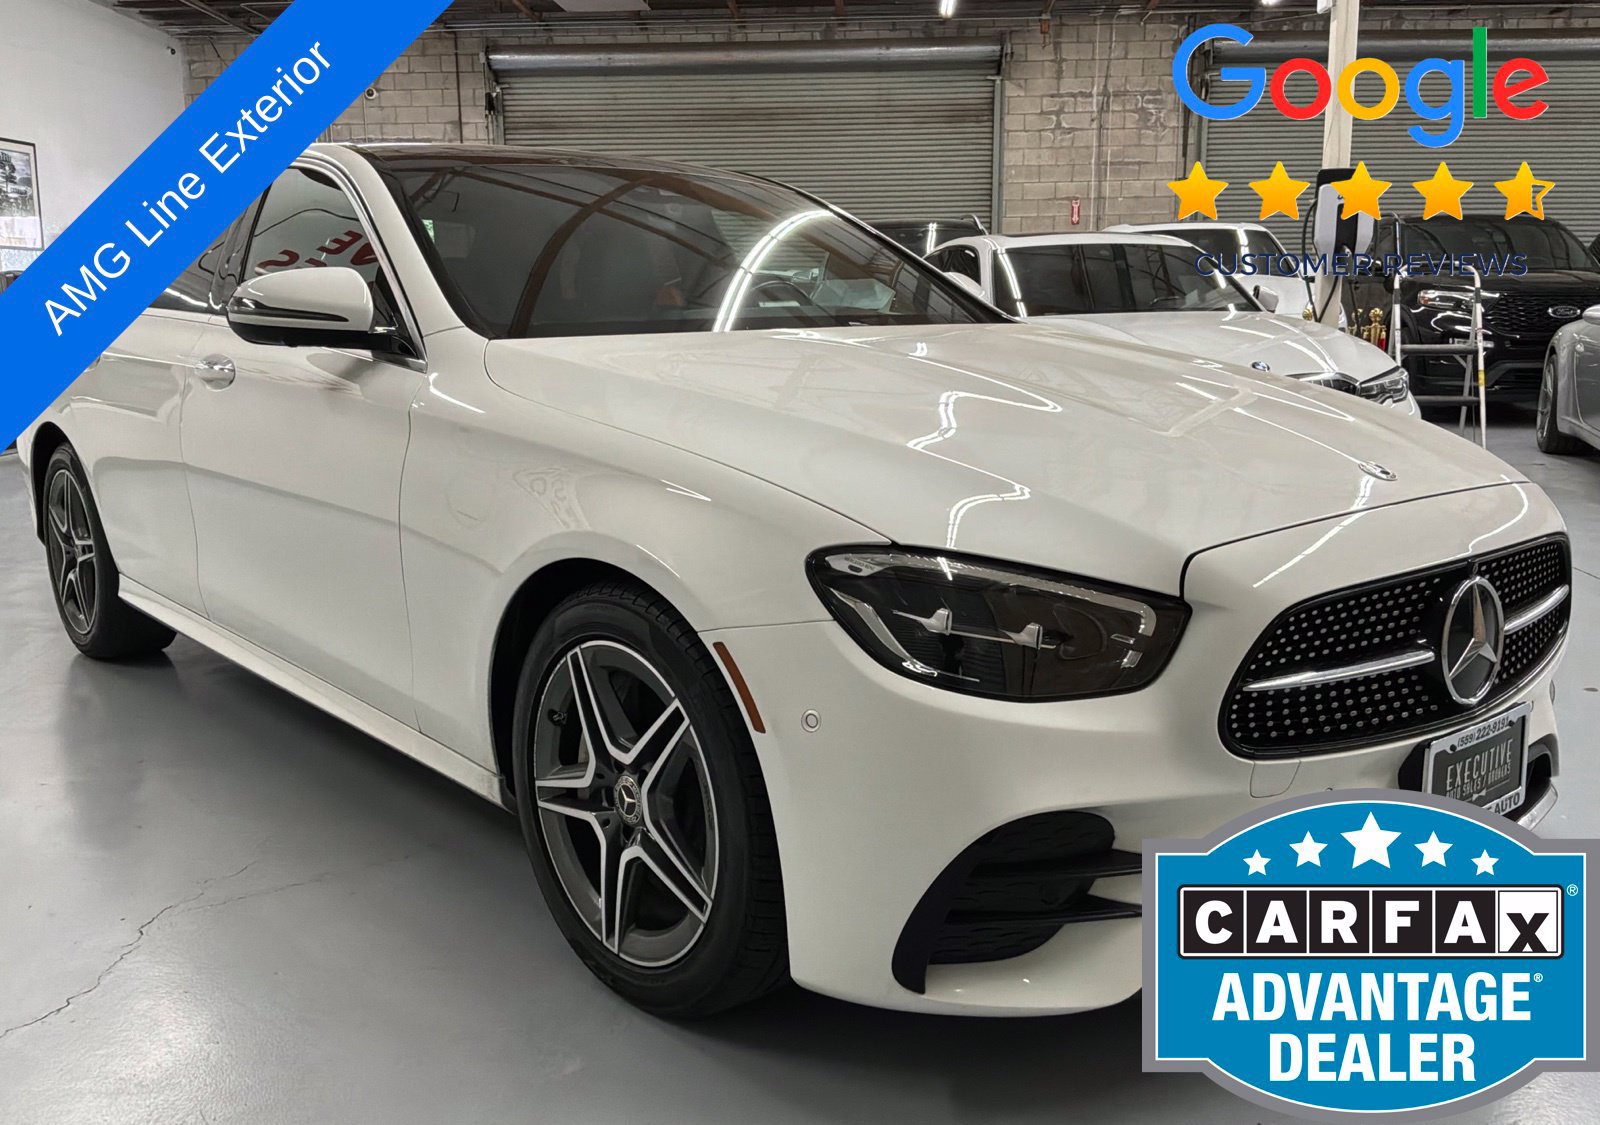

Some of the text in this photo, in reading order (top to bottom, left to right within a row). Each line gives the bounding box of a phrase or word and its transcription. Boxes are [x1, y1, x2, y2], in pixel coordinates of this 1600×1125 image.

[1446, 738, 1514, 791] EXECUTIVE
[1462, 777, 1481, 796] SALES
[1494, 793, 1520, 814] AUTO
